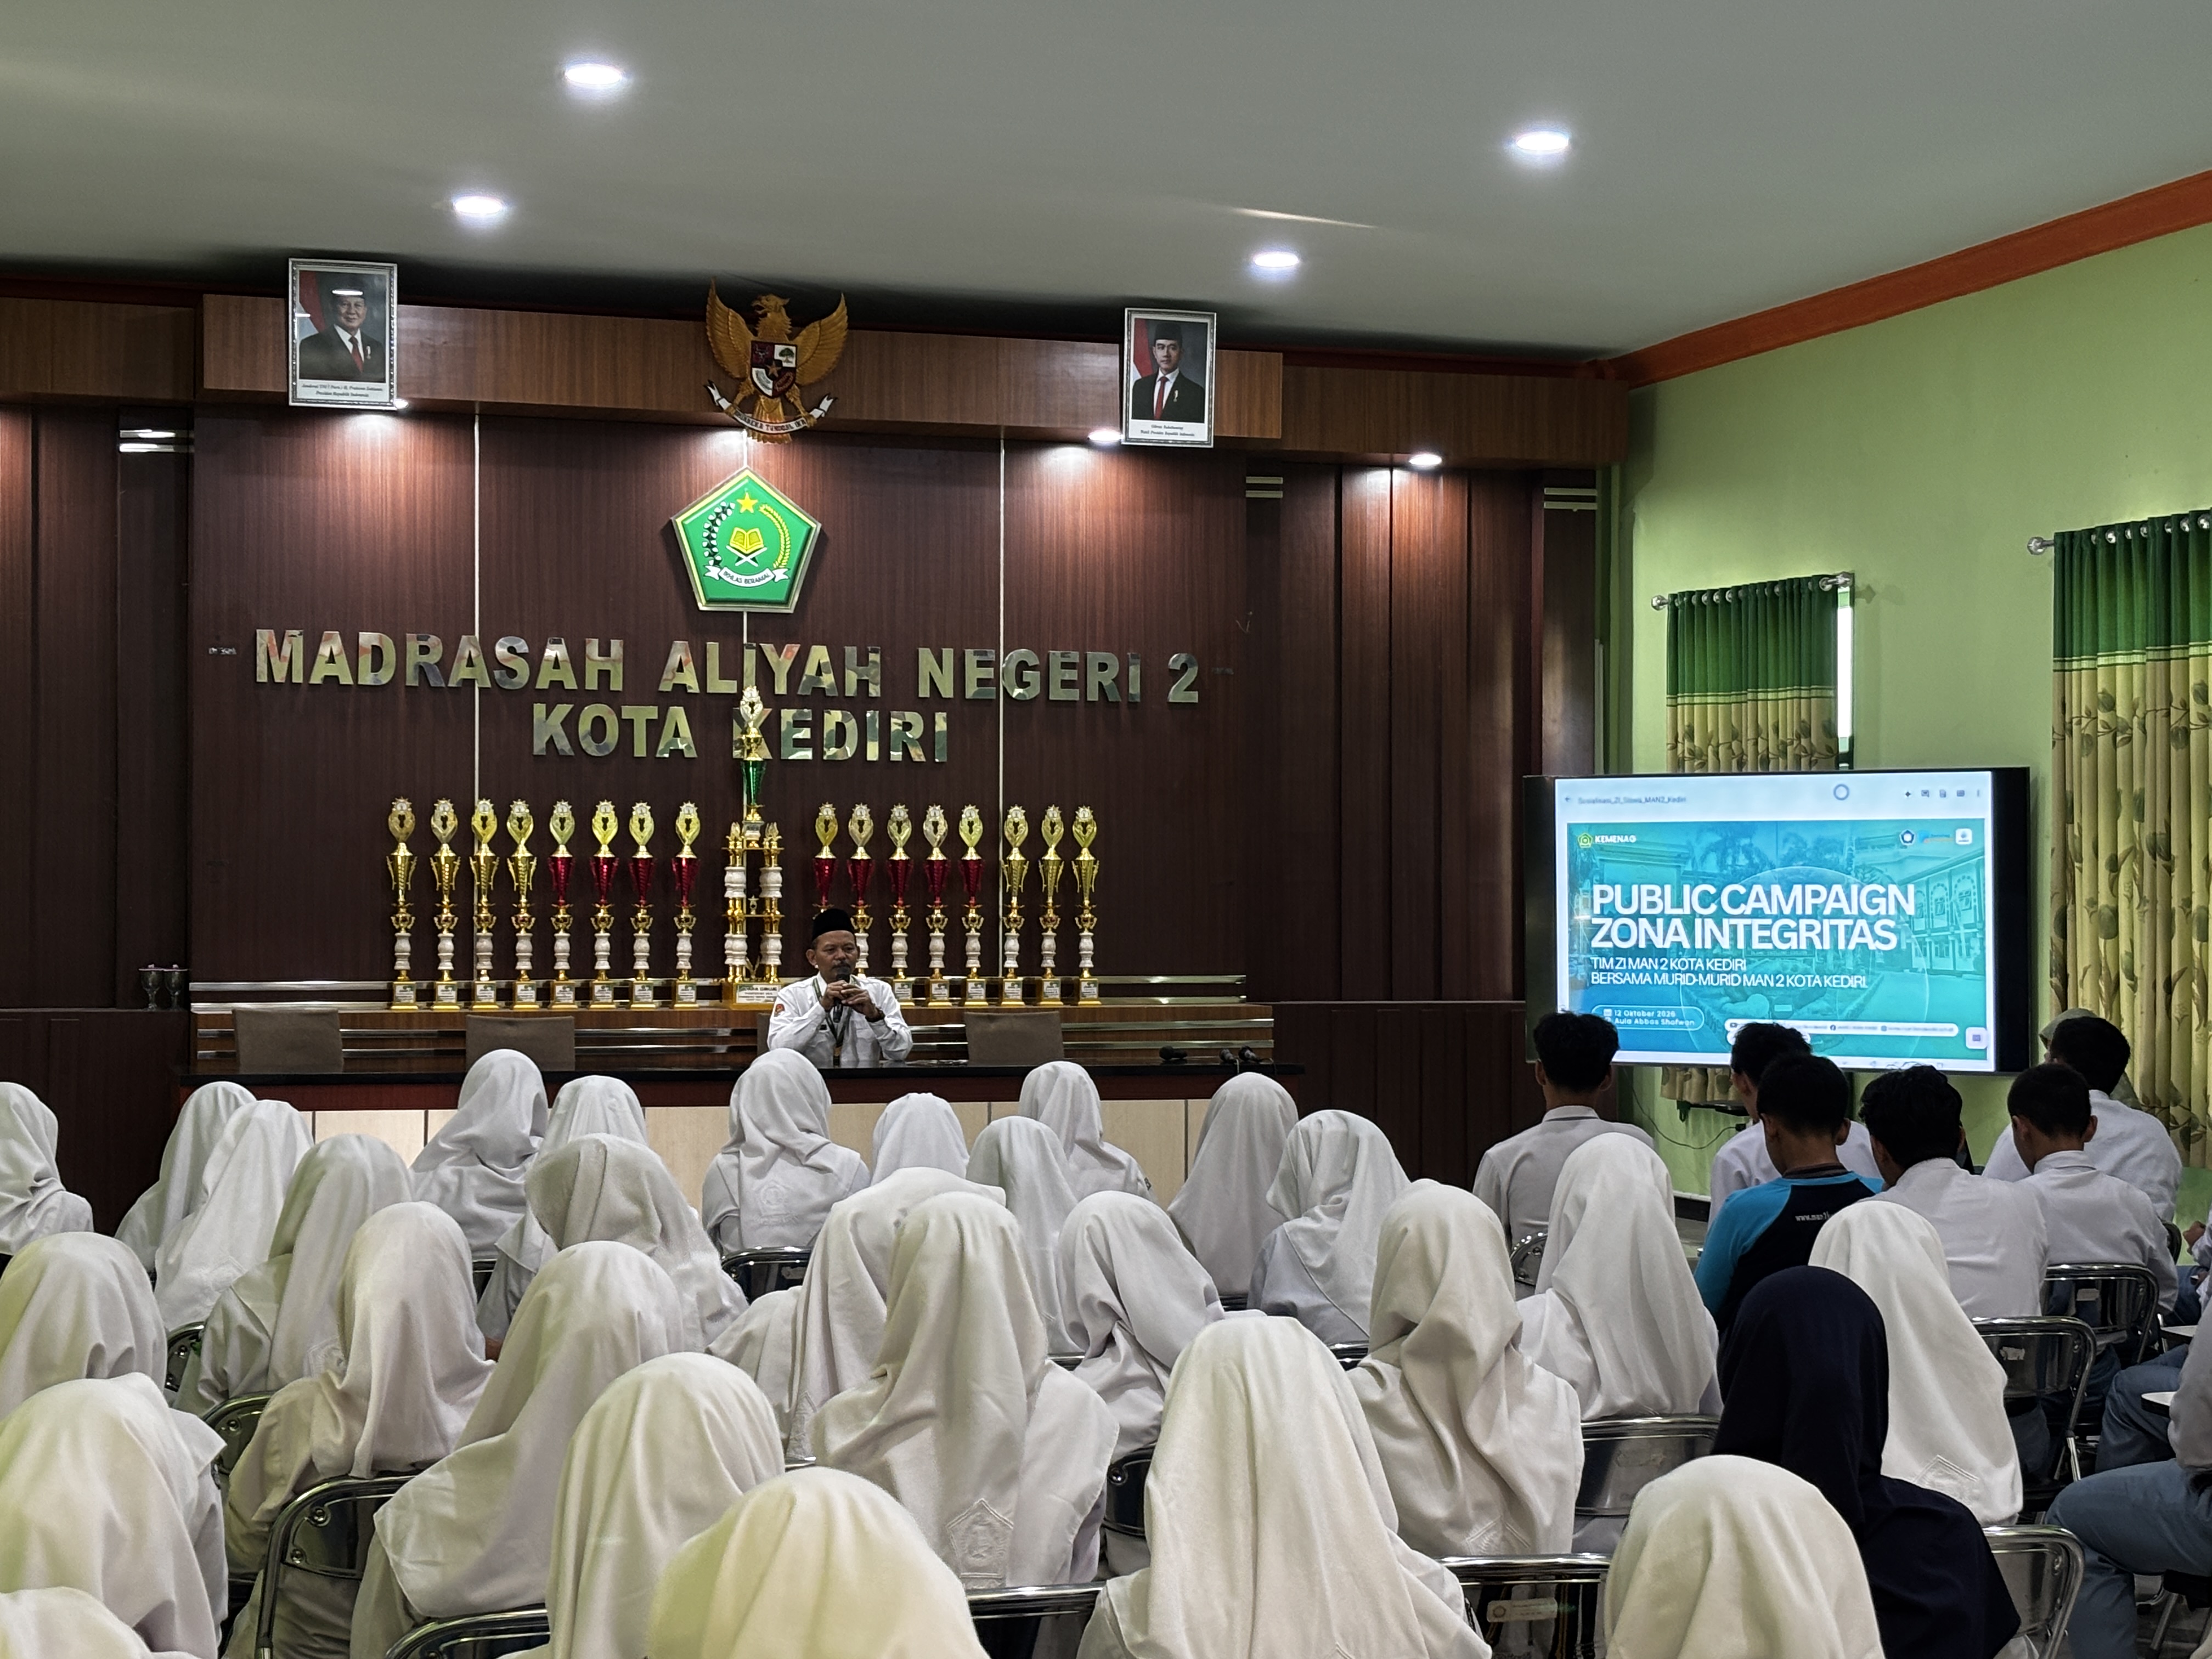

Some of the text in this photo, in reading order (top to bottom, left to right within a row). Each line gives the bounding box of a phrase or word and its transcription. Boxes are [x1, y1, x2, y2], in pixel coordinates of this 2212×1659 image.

[256, 629, 1199, 703] MADRASAH ALIYAH NEGERI 2
[533, 703, 697, 758] KOTA
[1594, 835, 1637, 843] KEMENAG
[1592, 883, 1915, 916] PUBLIC CAMPAIGN
[1591, 918, 1897, 950] ZONA INTEGRITAS
[1592, 957, 1746, 970] TIM ZI MAN 2 KOTA KEDIRI
[1592, 972, 1866, 988] BERSAMA MURID-MURID MAN 2 KOTA KEDIRI
